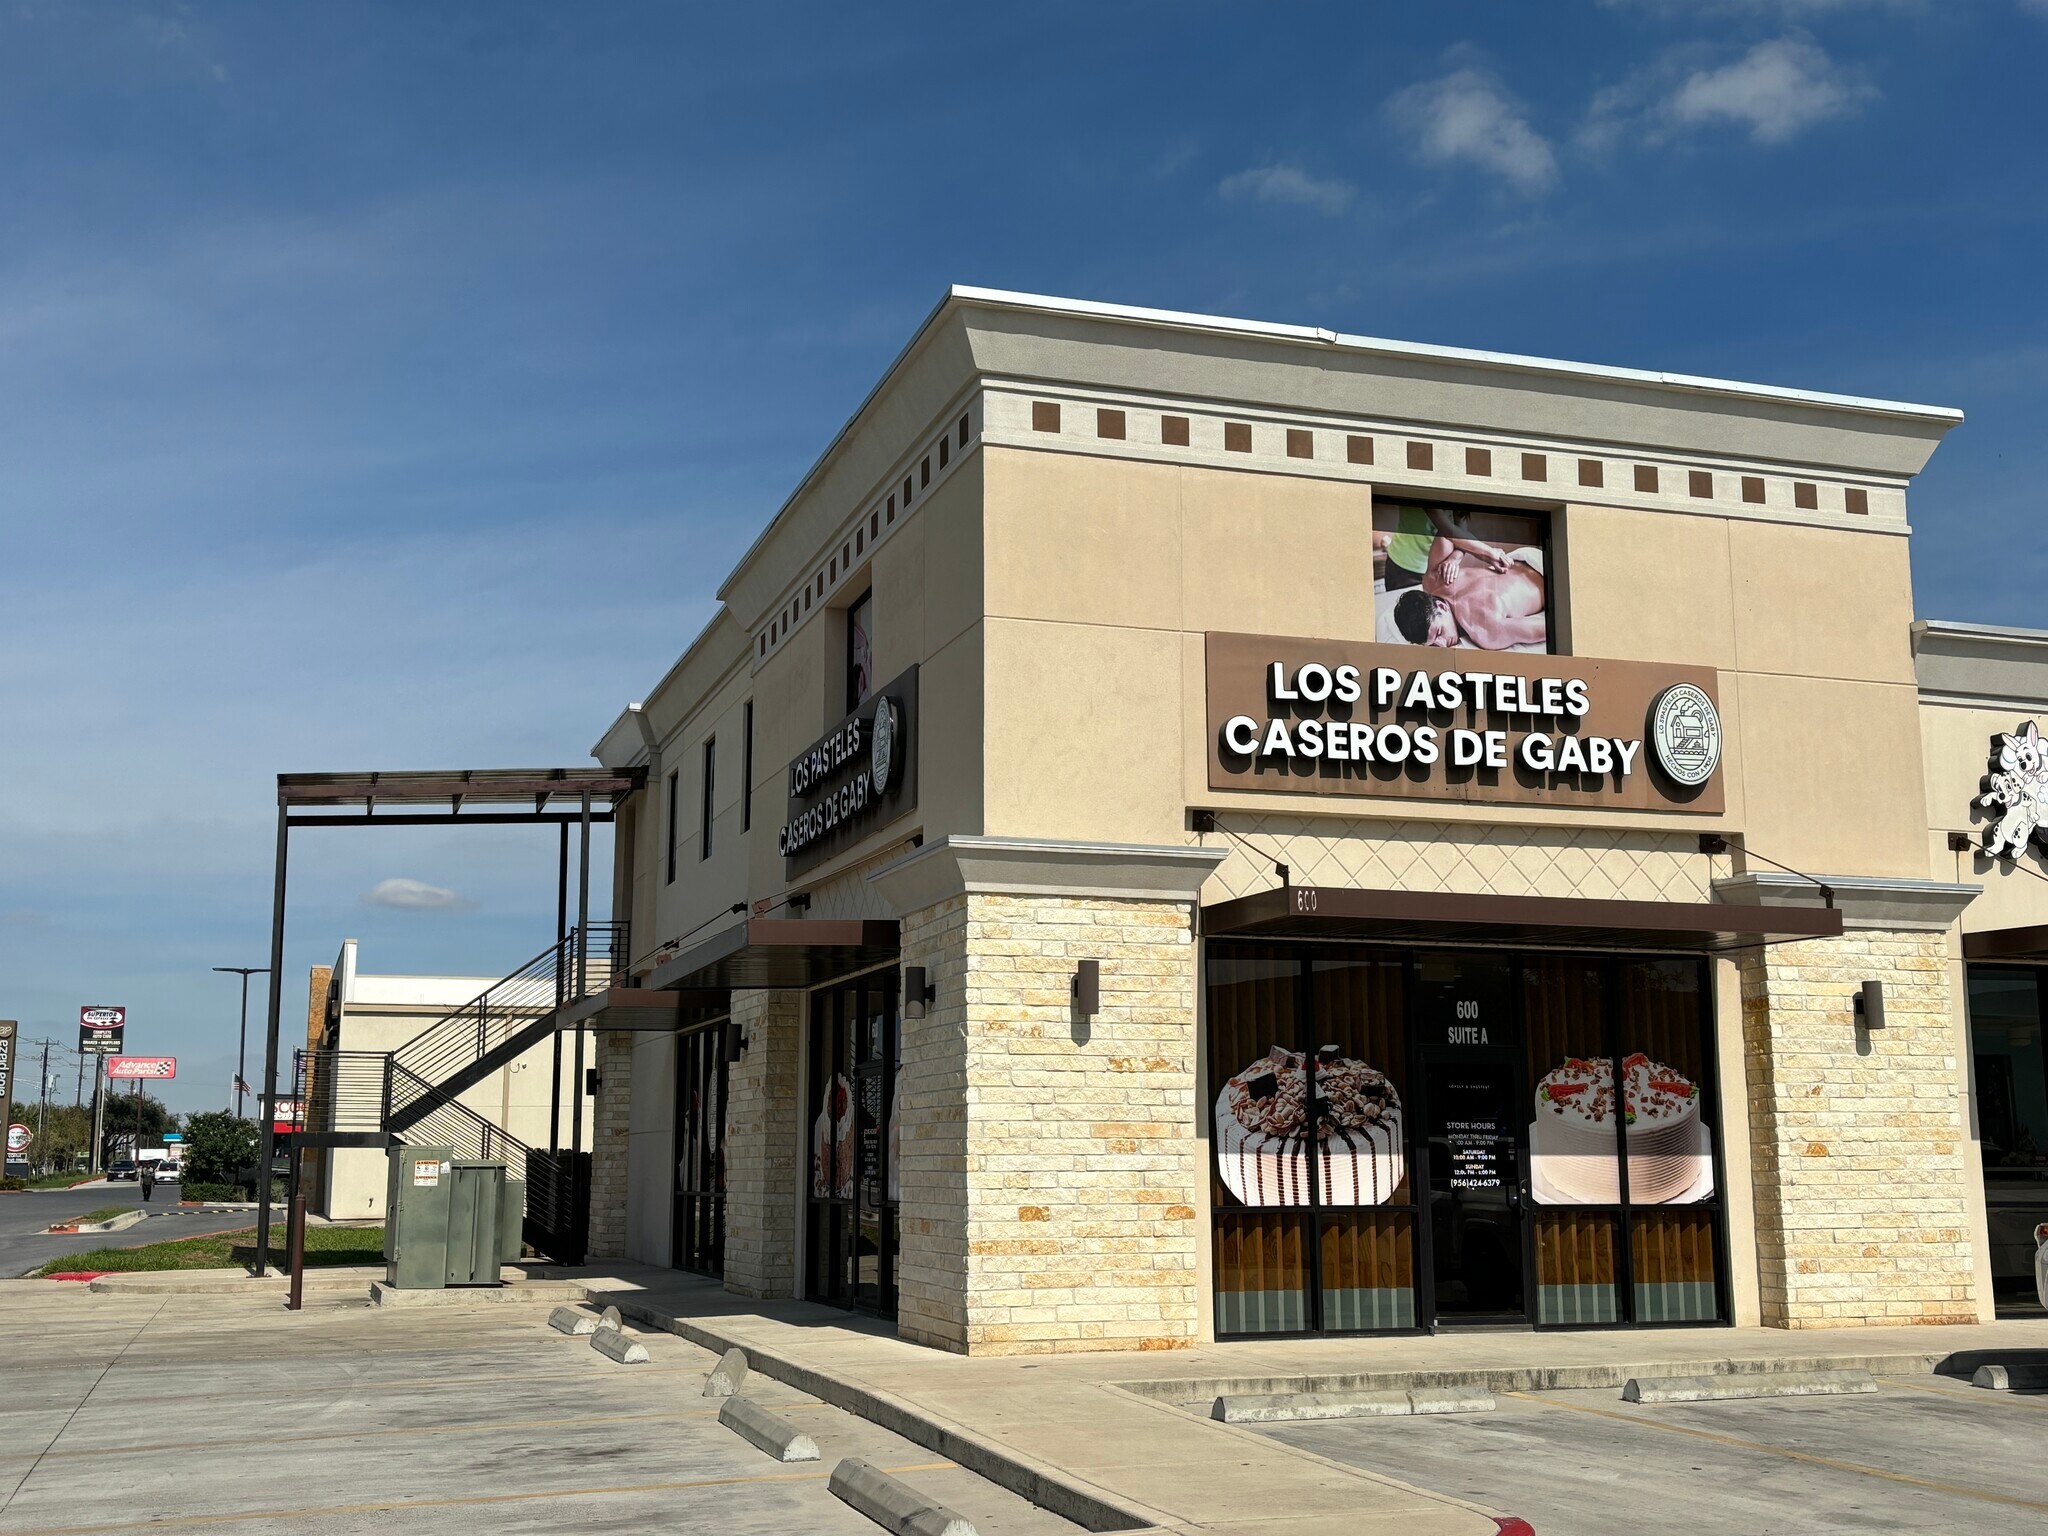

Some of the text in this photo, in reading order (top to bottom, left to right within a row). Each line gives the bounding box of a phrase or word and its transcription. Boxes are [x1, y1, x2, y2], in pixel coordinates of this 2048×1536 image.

[1273, 661, 1591, 716] LOS PASTELES
[1660, 692, 1678, 719] PASTELES
[1679, 690, 1706, 707] CASEROS
[1704, 706, 1711, 716] DE
[1708, 716, 1717, 737] GABY
[1225, 714, 1642, 776] CASEROS DE GABY
[790, 756, 809, 798] LOS
[810, 717, 861, 784] PASTELES
[1665, 754, 1686, 777] HECHOS
[778, 768, 871, 858] CASEROS DE GABY
[1456, 1000, 1479, 1019] 600
[1447, 1026, 1489, 1045] SUITE A
[111, 1067, 155, 1075] Auto Parts
[116, 1060, 157, 1069] Advance
[1446, 1122, 1496, 1130] STORE HOURS
[1450, 1178, 1501, 1188] (956)424-6379
